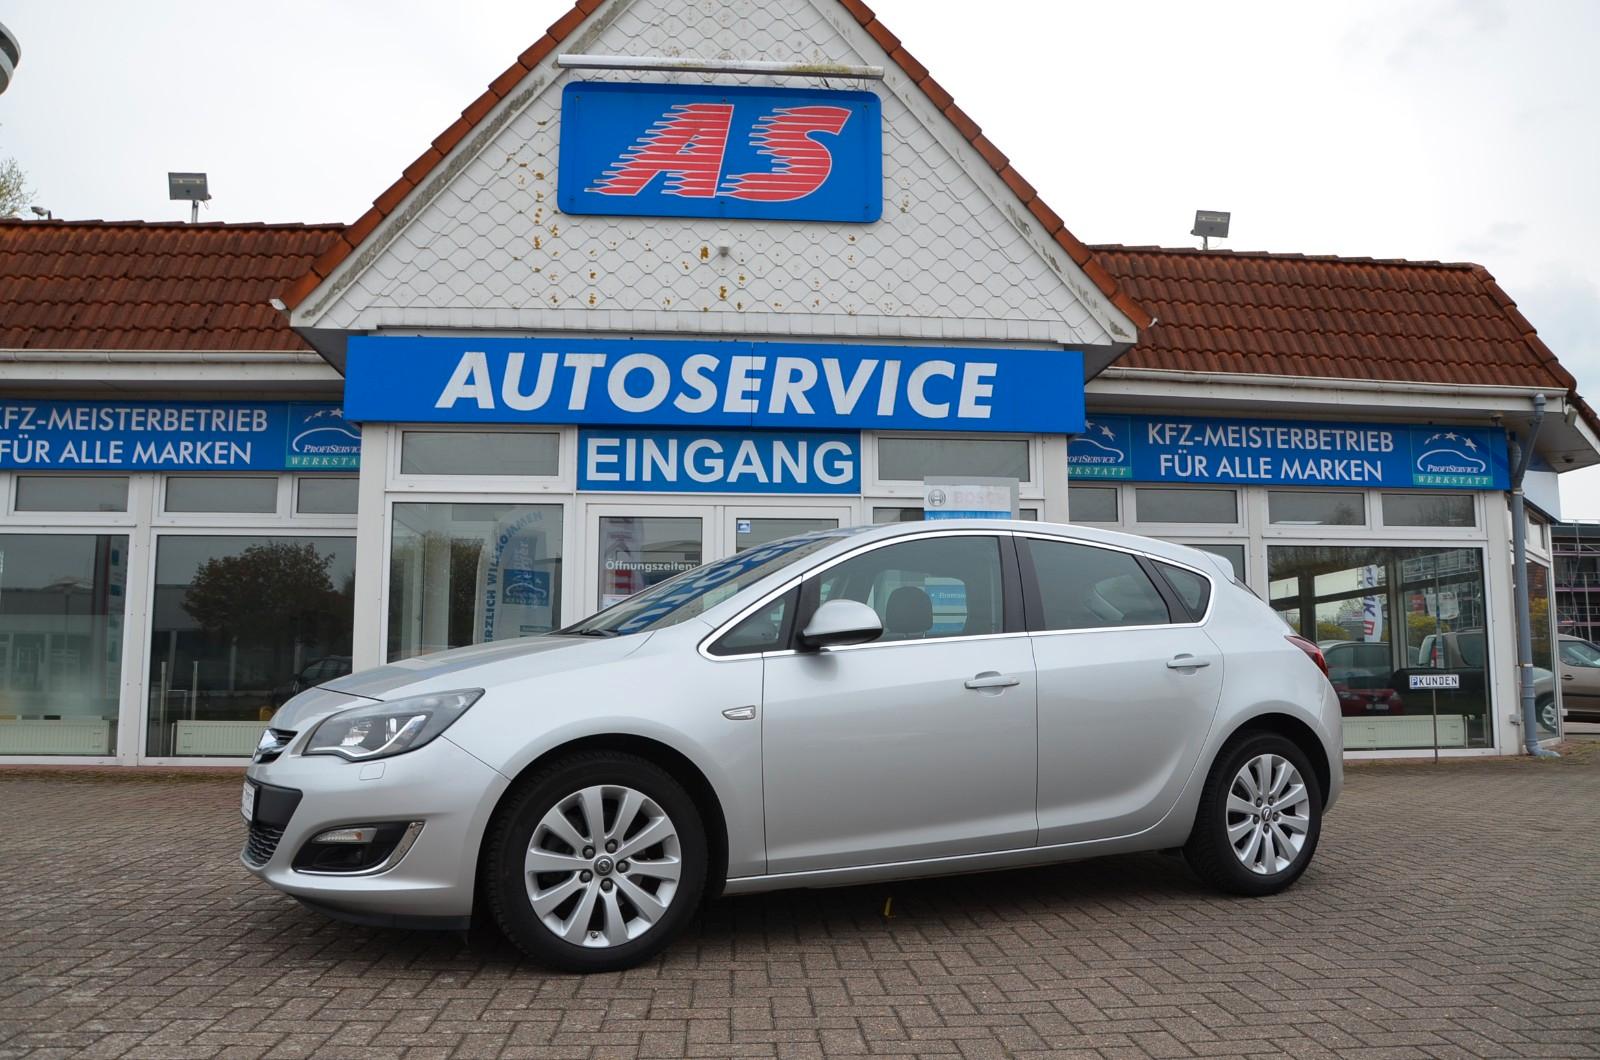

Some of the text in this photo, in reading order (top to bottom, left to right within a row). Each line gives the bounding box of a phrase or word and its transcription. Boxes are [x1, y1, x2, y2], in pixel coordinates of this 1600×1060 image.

[584, 103, 852, 202] AS
[434, 351, 998, 419] AUTOSERVICE
[0, 406, 268, 432] FZ-MEISTERBETRIEB
[0, 434, 252, 465] FÜR ALLE MARKEN
[1147, 423, 1394, 453] KFZ-MEISTERBETRIEB
[586, 438, 854, 485] EINGANG
[1159, 448, 1383, 482] FÜR ALLE MARKEN
[1418, 475, 1489, 485] WERKSTATT
[1419, 676, 1457, 686] KUNDEN
